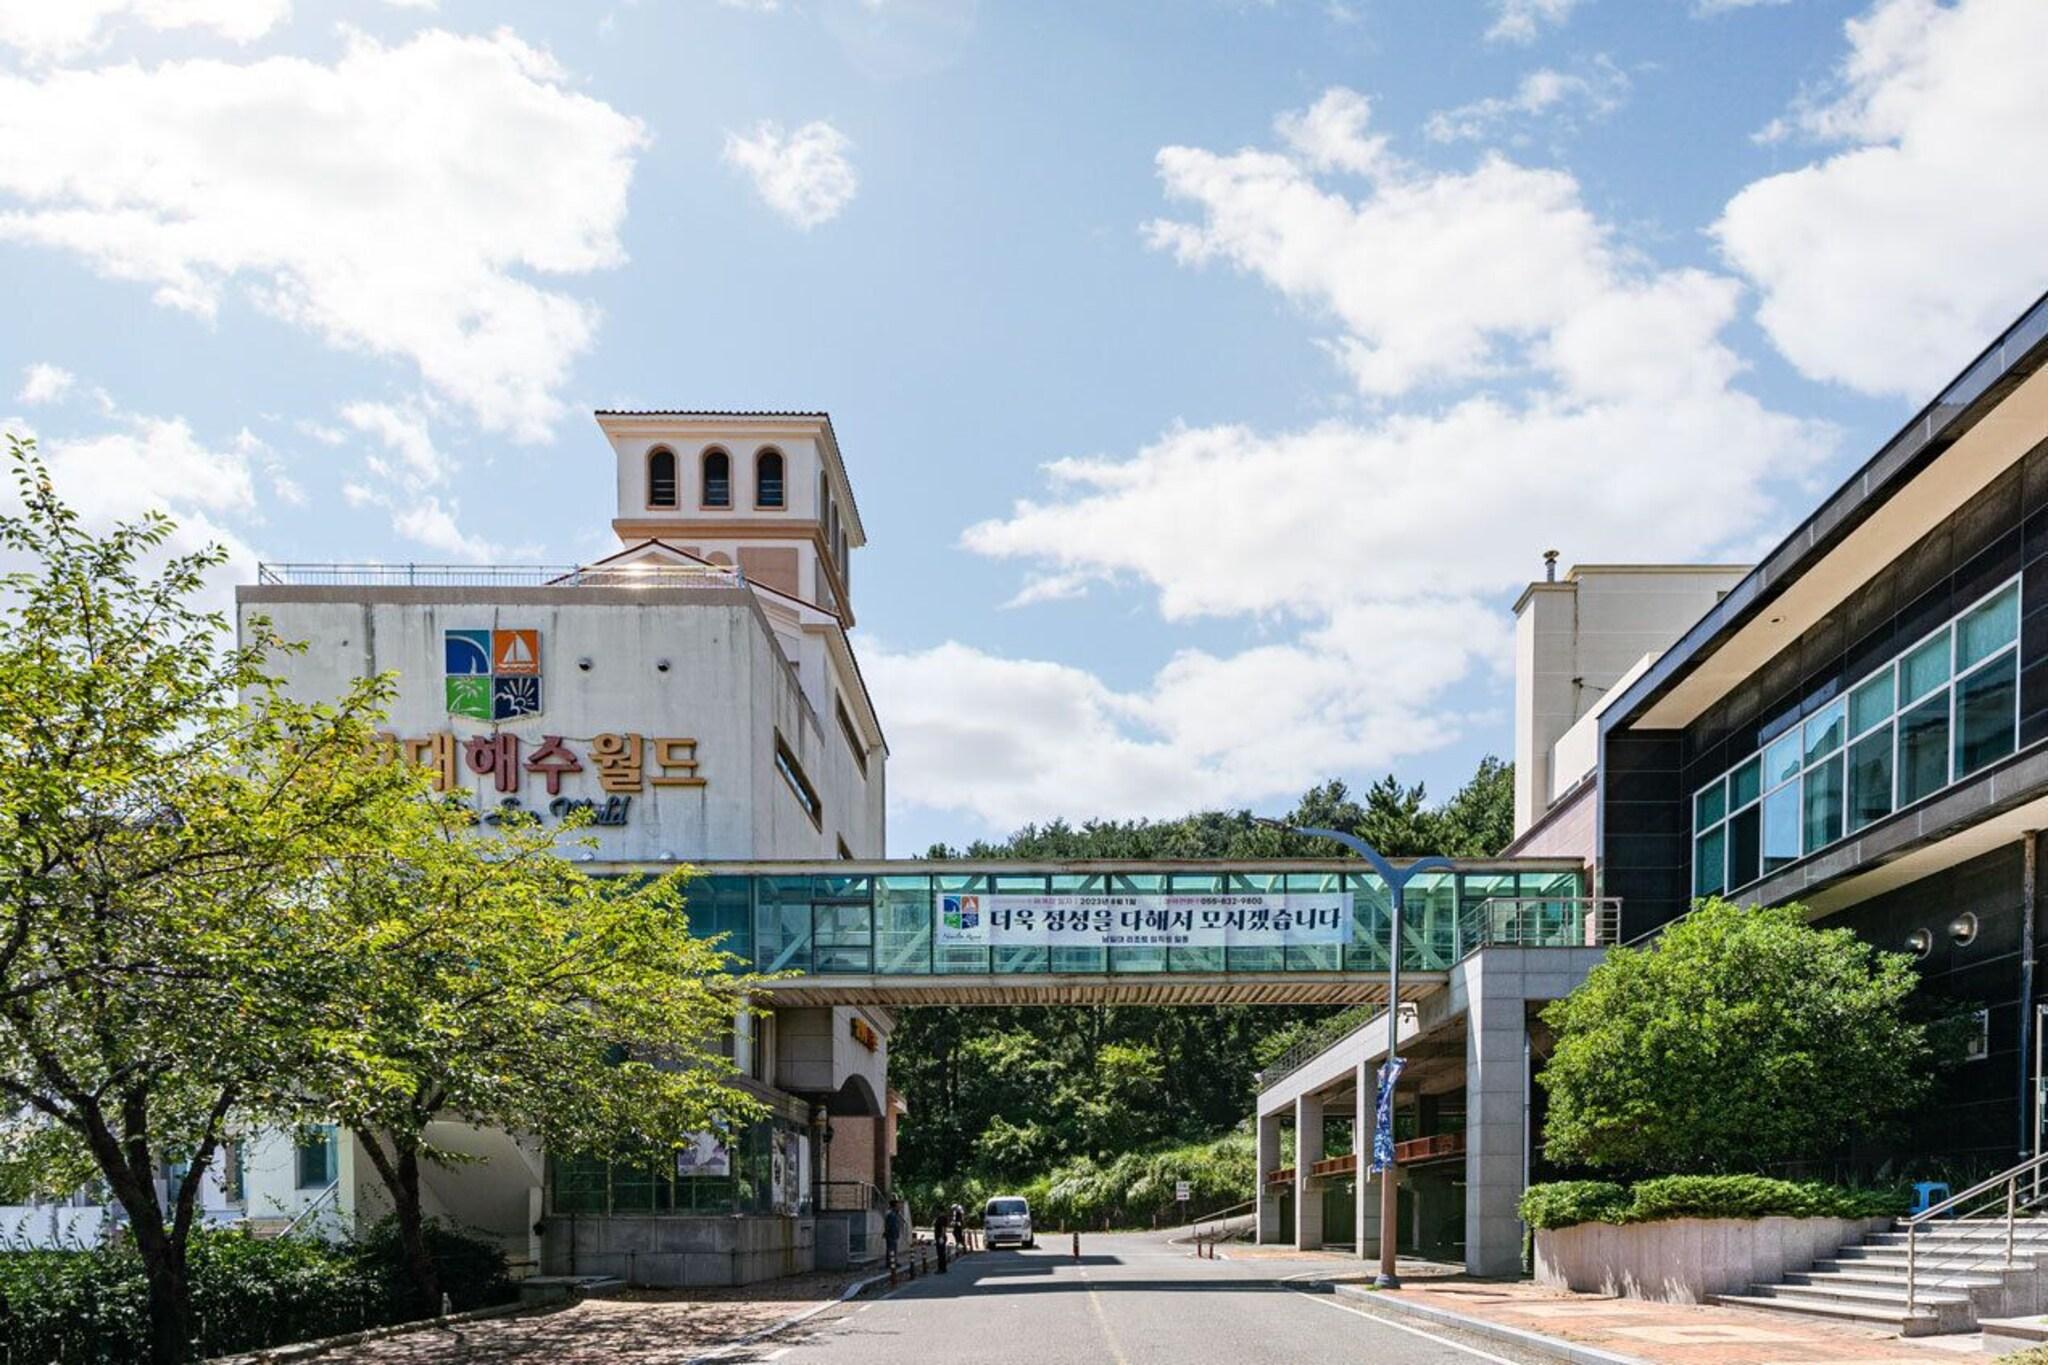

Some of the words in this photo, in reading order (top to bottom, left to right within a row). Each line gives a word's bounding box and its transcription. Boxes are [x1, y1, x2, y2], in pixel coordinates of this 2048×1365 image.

[1080, 896, 1109, 906] 2023년
[1201, 896, 1263, 906] 055-832-9800
[990, 908, 1036, 932] 더욱
[1042, 908, 1114, 933] 정성을
[1120, 908, 1193, 932] 다해서
[1199, 907, 1342, 932] 모시겠습니다
